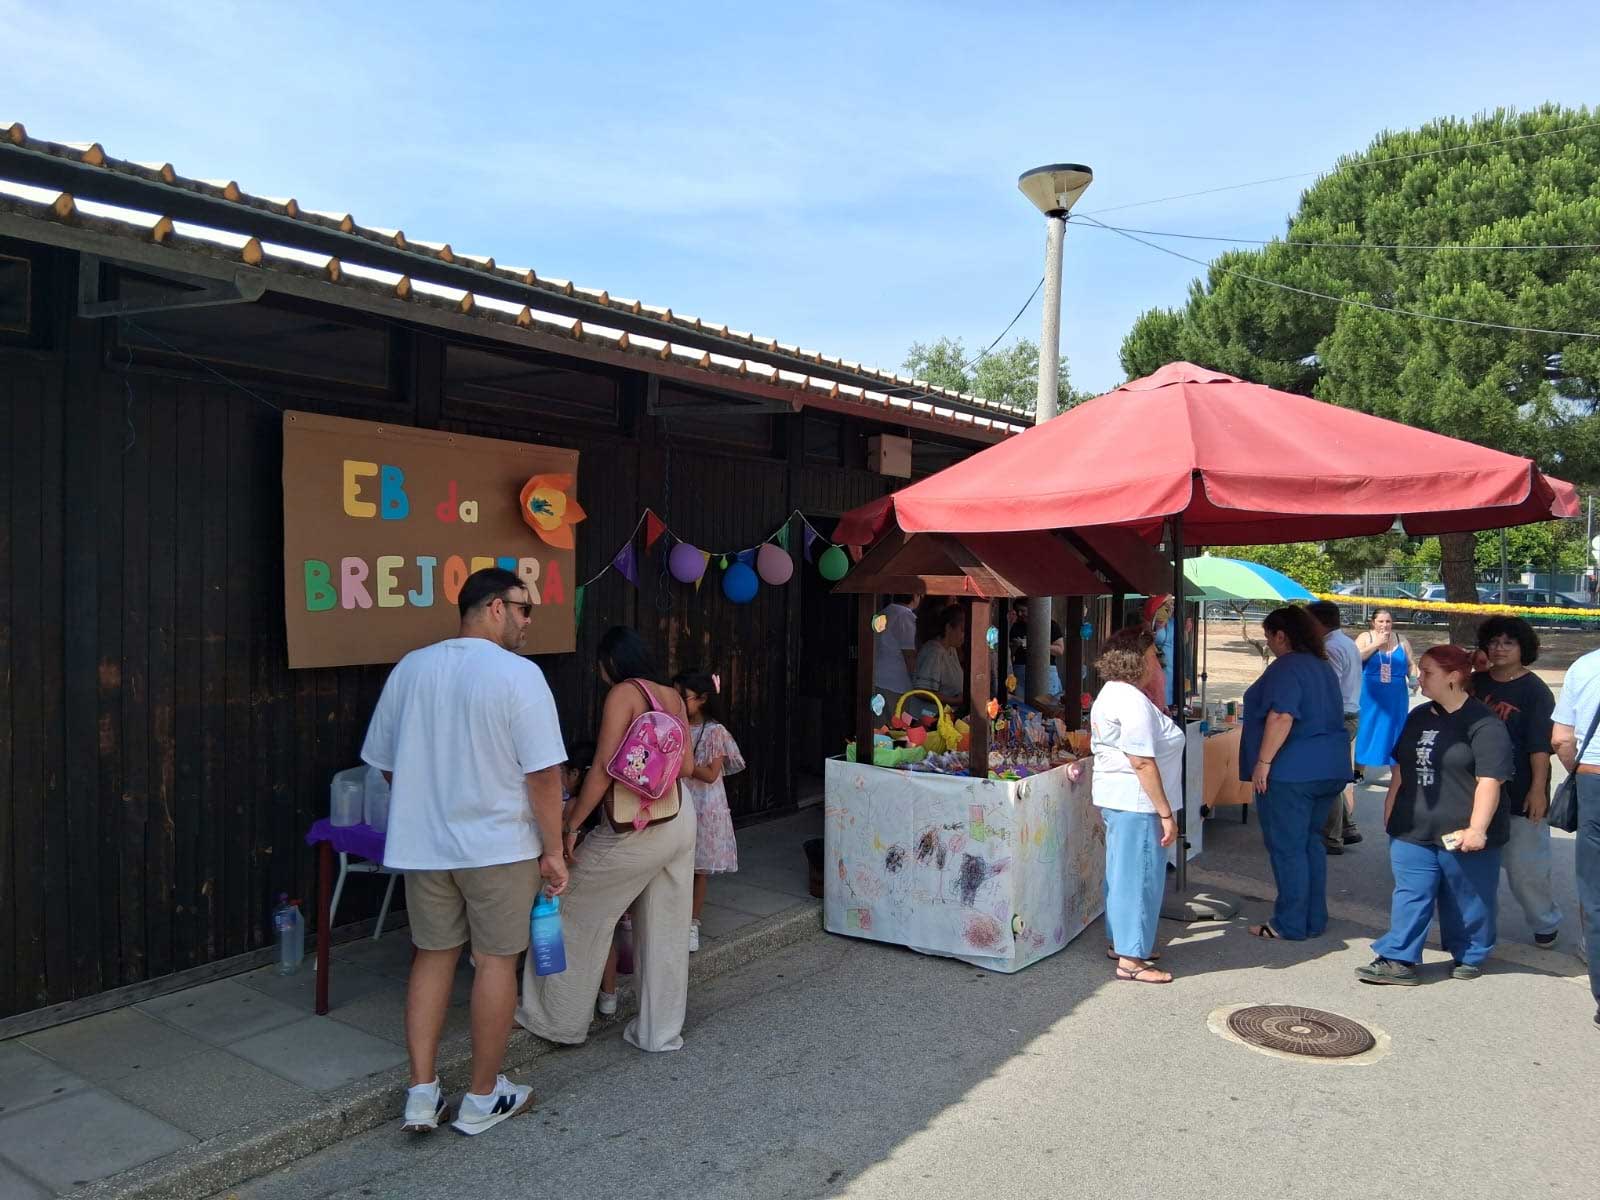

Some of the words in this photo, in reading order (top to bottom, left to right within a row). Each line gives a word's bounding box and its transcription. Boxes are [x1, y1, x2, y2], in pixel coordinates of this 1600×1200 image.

[343, 459, 410, 520] EB
[435, 479, 479, 524] da
[304, 554, 565, 613] BREJORA
[1415, 729, 1440, 787] 東京市
